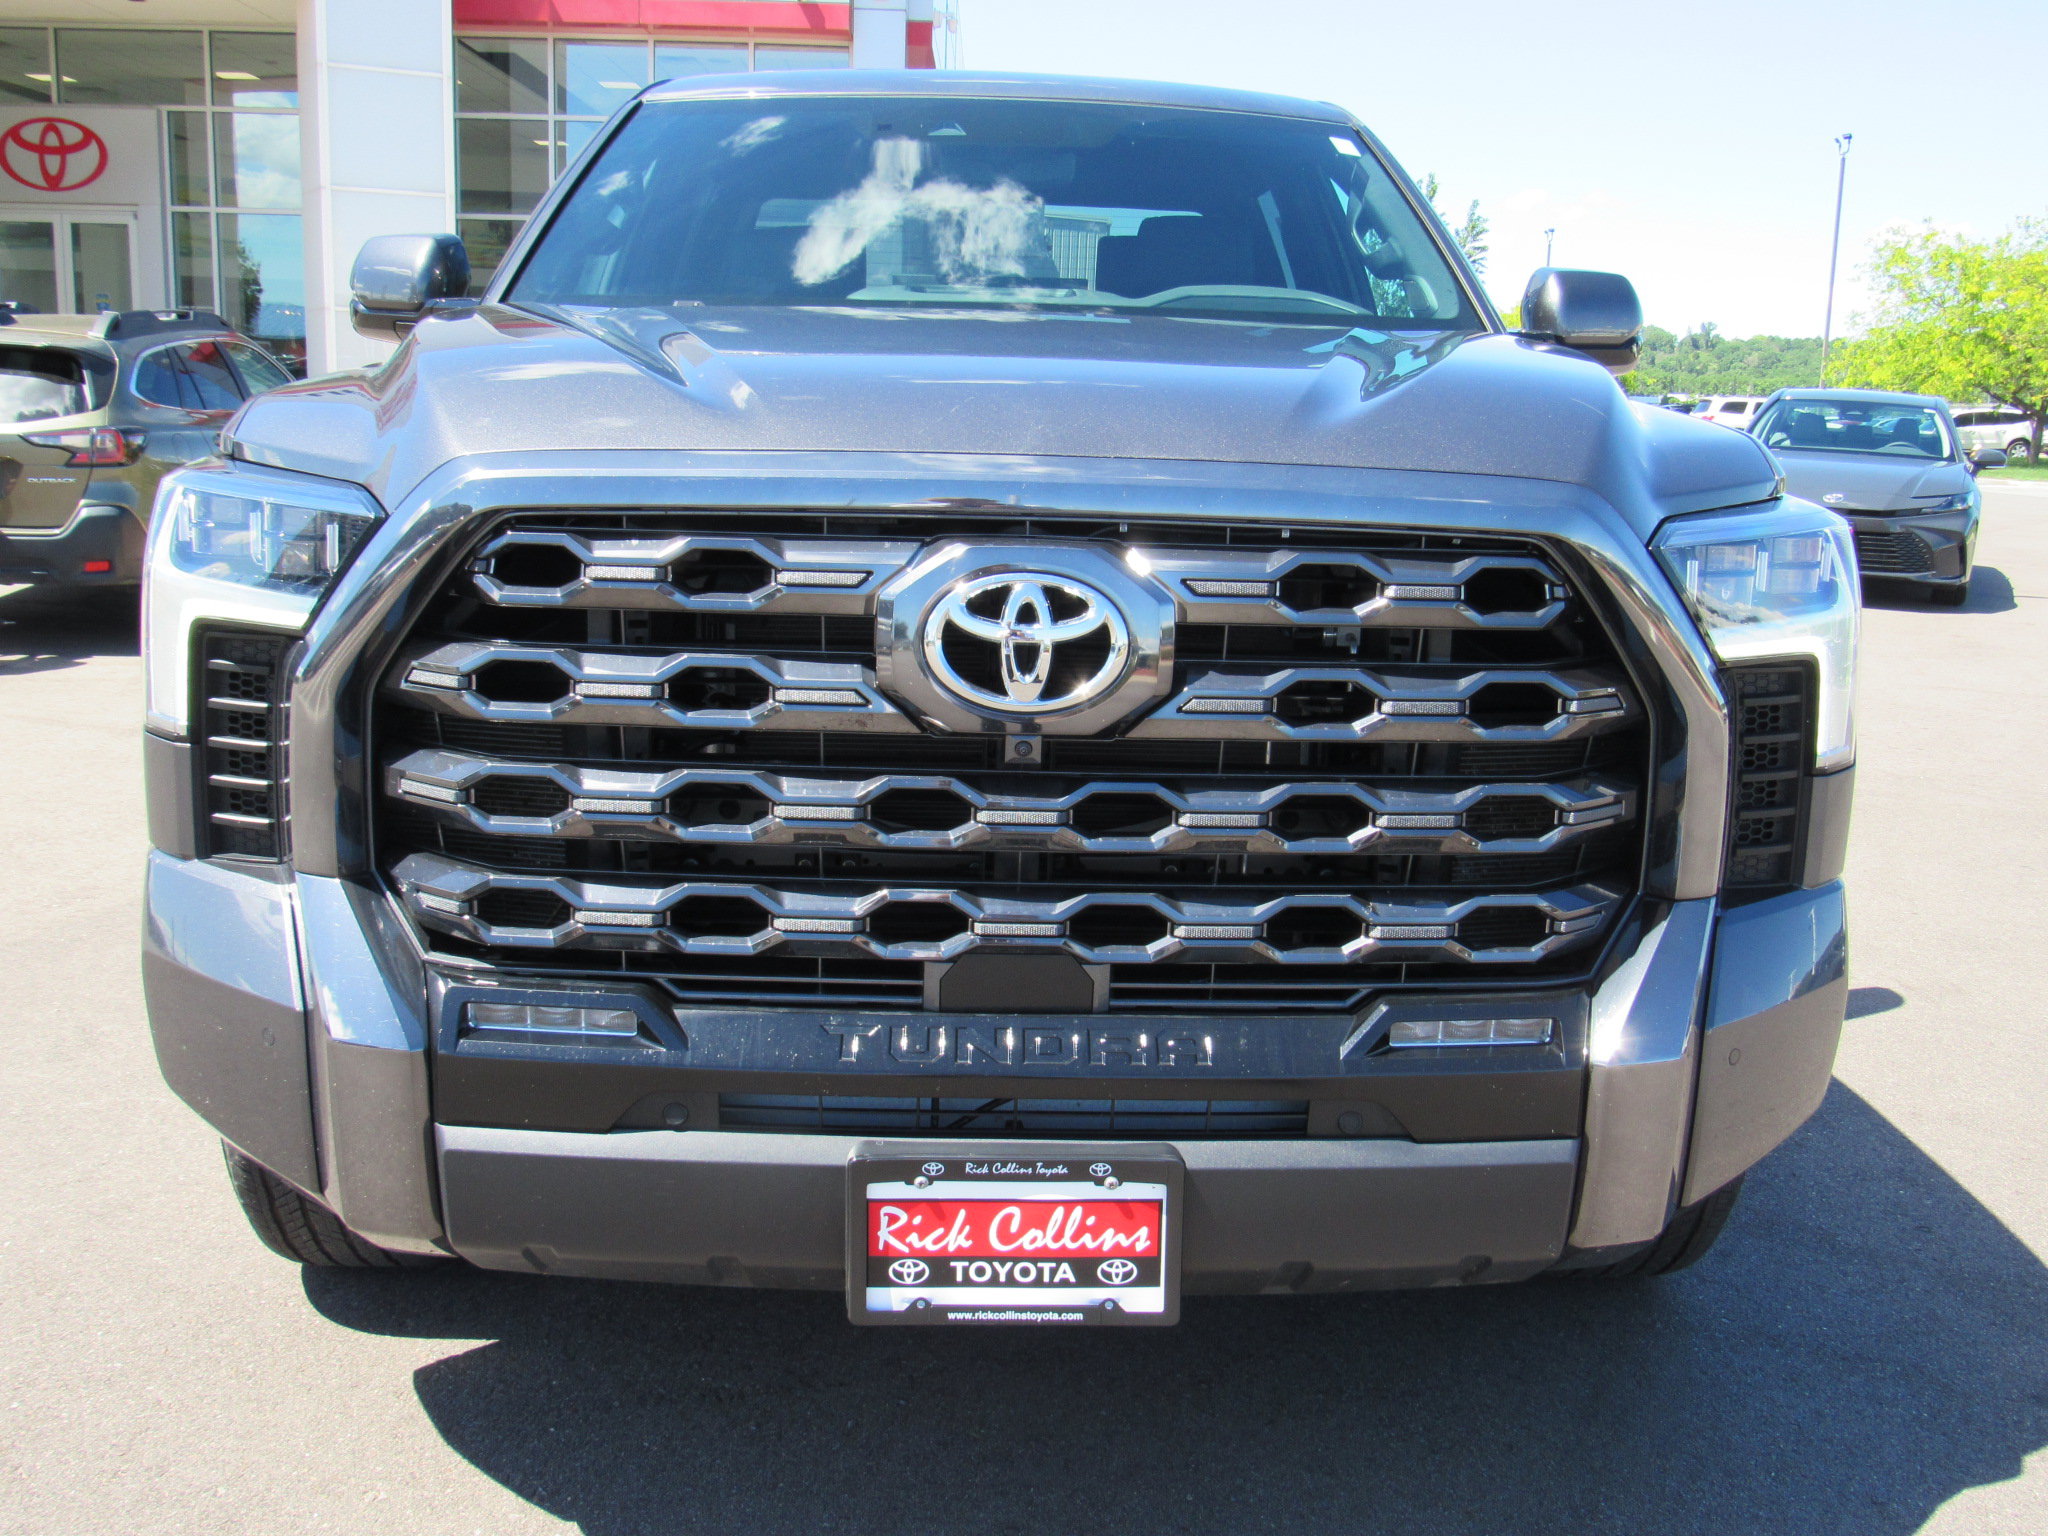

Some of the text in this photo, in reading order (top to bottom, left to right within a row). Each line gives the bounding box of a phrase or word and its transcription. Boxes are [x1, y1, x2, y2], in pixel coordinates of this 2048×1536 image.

[820, 1025, 1213, 1067] TUNDRA
[965, 1162, 1068, 1176] Rick Collins Toyota
[877, 1205, 1151, 1253] Rick Collins
[949, 1261, 1076, 1284] TOYOTA
[947, 1310, 1083, 1321] www.rickcollinstoyota.com
